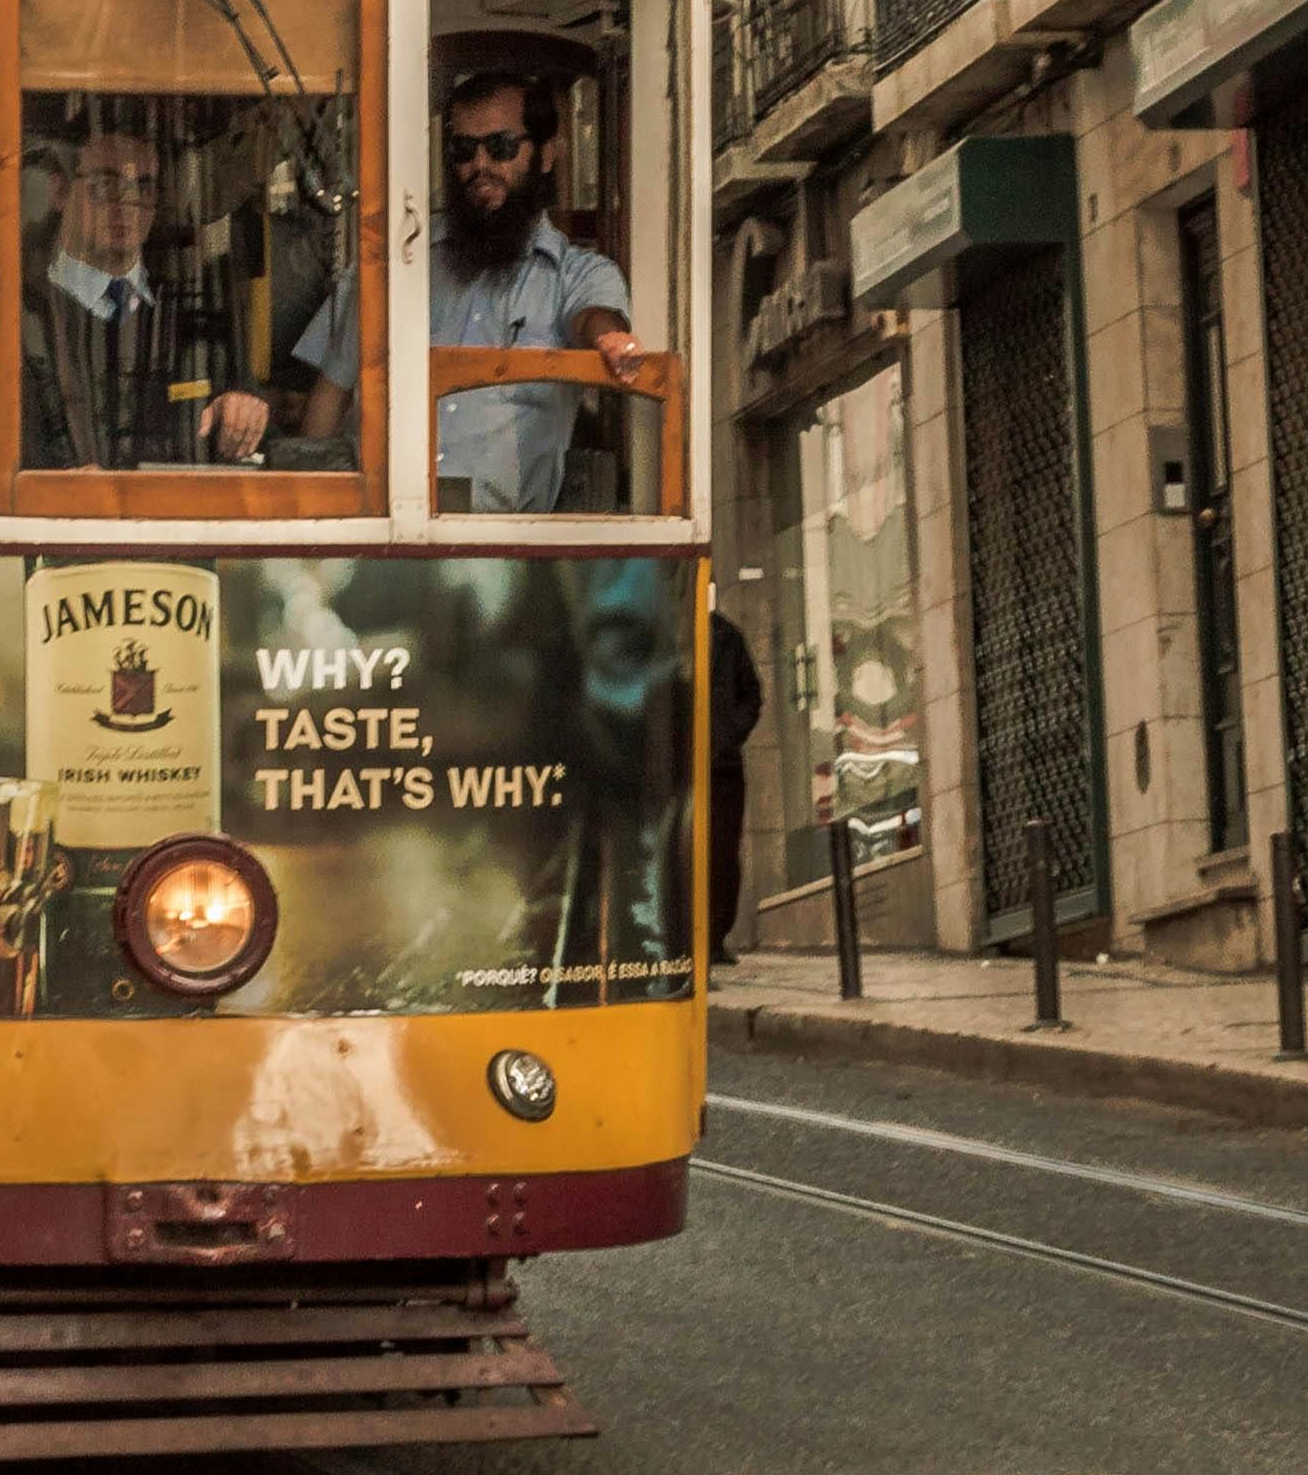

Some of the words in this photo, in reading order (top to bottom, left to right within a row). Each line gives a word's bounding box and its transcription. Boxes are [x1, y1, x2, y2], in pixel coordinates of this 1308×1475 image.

[42, 588, 213, 644] JAMESON
[255, 645, 412, 693] WHY?
[255, 706, 435, 757] TASTE,
[57, 767, 111, 784] IRISH
[117, 764, 202, 784] WHISKEY
[255, 767, 434, 812] THAT'S
[539, 966, 552, 983] O
